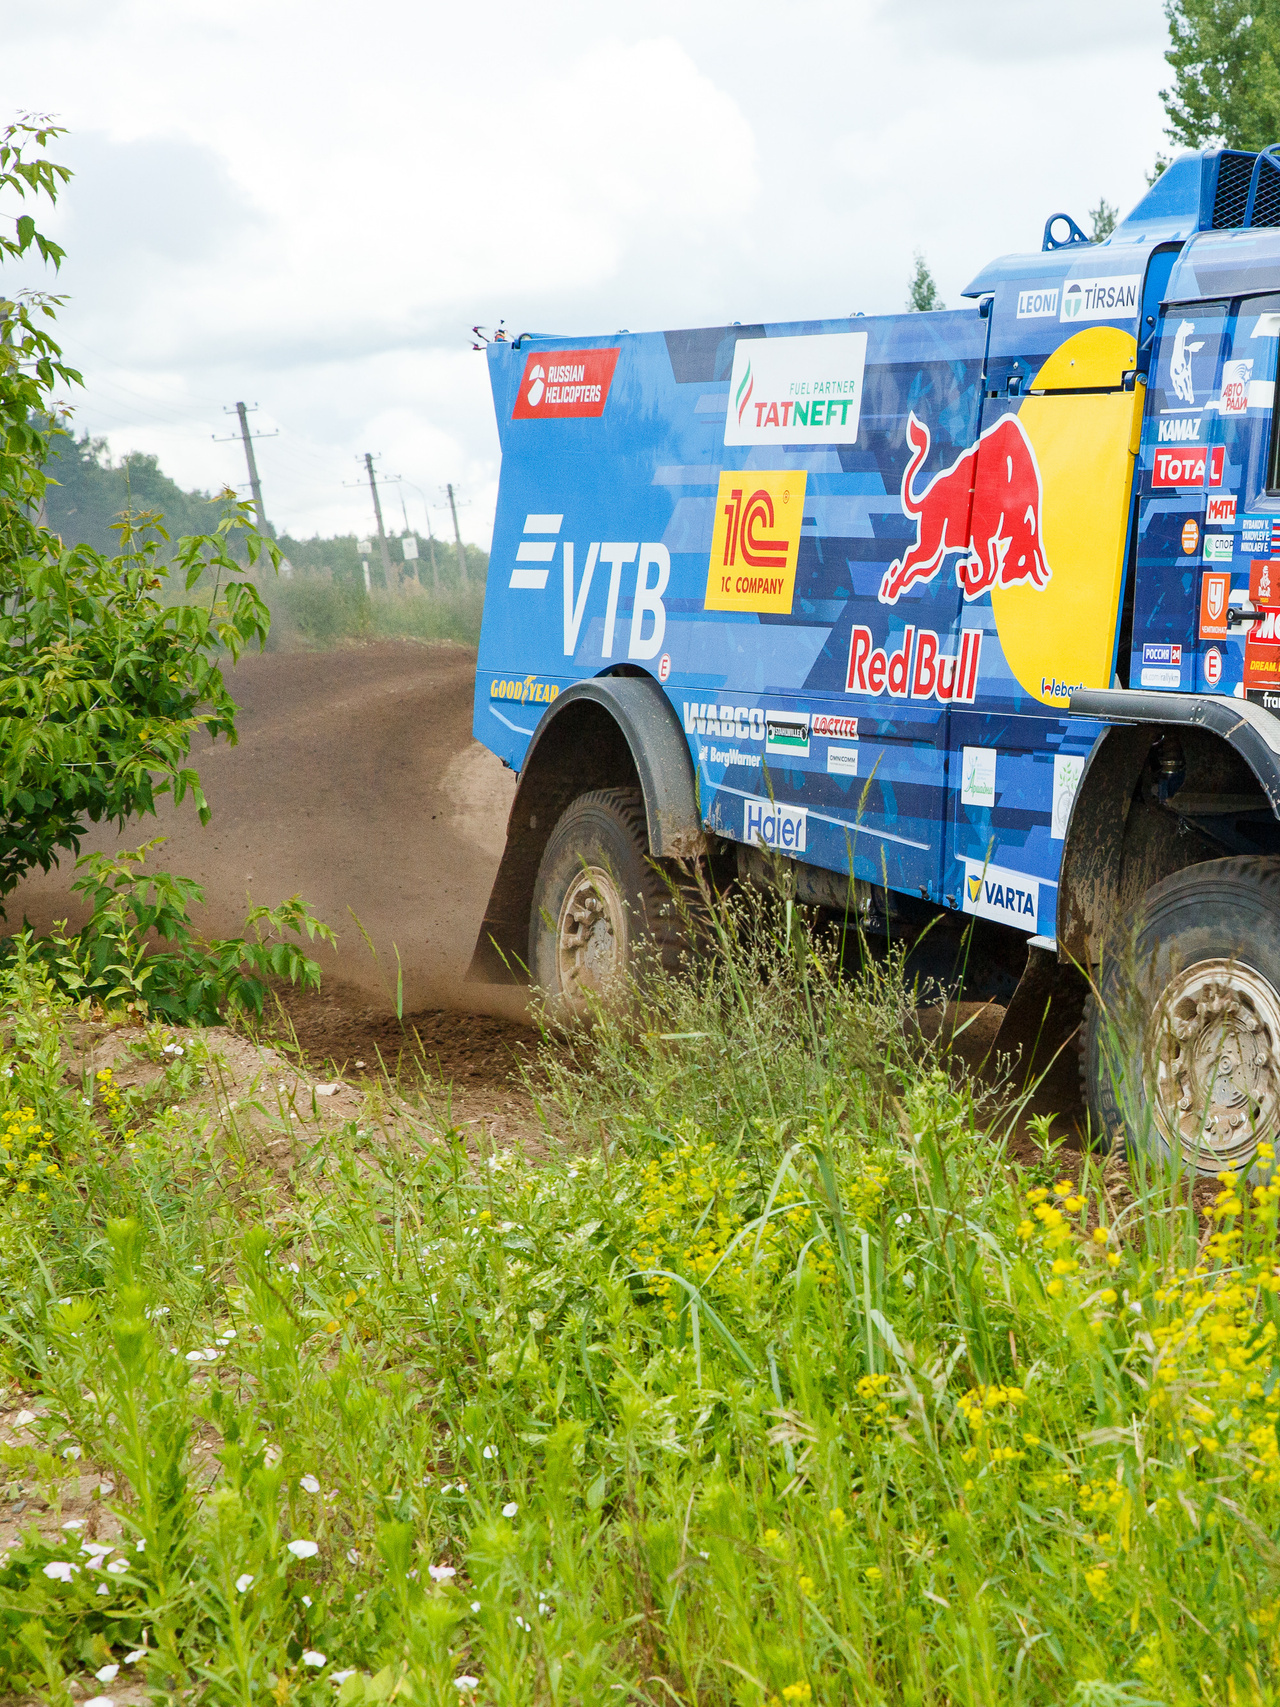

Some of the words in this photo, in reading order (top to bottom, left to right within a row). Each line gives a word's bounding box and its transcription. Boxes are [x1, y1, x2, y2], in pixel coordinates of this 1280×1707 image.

[1018, 293, 1057, 314] LEONI
[547, 364, 585, 383] RUSSIAN
[544, 384, 602, 404] HELICOPTERS
[789, 382, 811, 396] FUEL
[813, 380, 855, 395] PARTNER
[1222, 382, 1243, 398] АВТО
[754, 399, 853, 428] TATNEFT
[1157, 418, 1202, 442] KAMAZ
[1157, 454, 1220, 480] TOTAL
[1208, 500, 1237, 519] МАТЧ
[721, 575, 732, 593] 1C
[736, 576, 784, 595] COMPANY
[563, 542, 671, 660] VTB
[846, 626, 914, 695] Red
[912, 631, 982, 702] Bull
[1145, 648, 1170, 660] РОССИЯ
[1172, 649, 1180, 660] 24
[1249, 660, 1278, 673] DREAM.
[682, 702, 765, 741] WABCO
[812, 716, 857, 738] LOCTITE
[709, 746, 761, 768] BorgWarner
[747, 805, 802, 848] Haier
[984, 880, 1035, 917] VARTA
